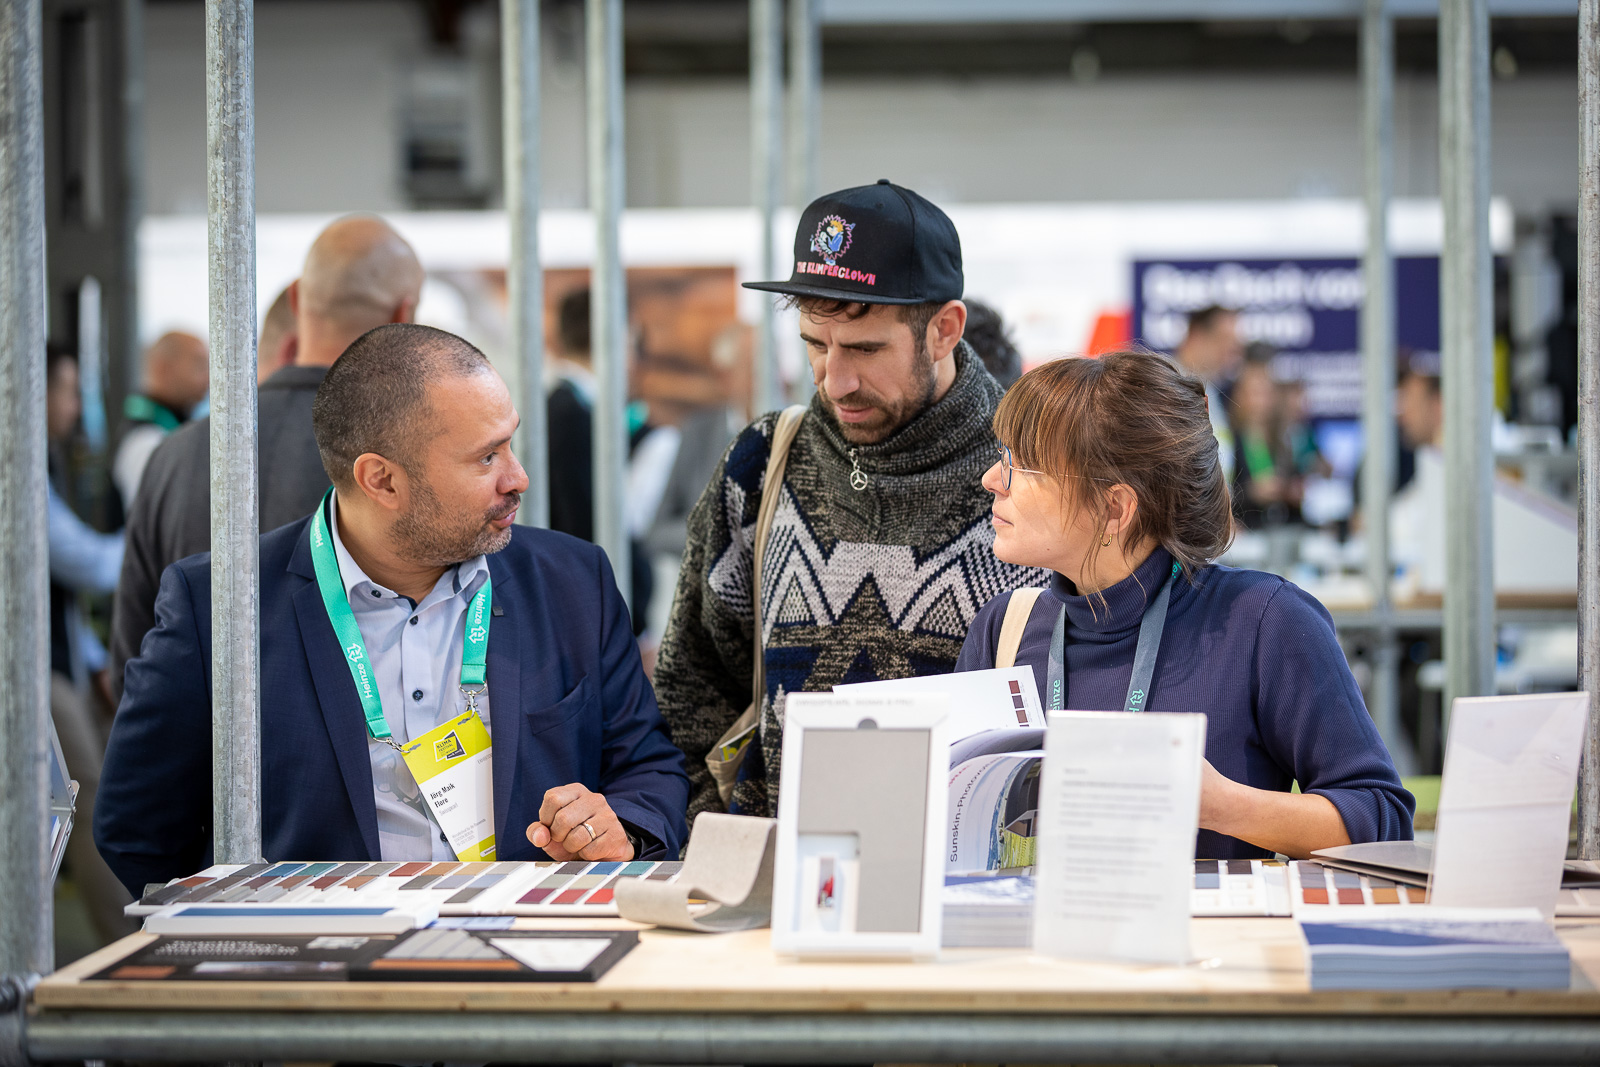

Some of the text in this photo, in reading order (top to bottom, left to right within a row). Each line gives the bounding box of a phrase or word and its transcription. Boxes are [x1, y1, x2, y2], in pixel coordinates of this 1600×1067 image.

[474, 592, 486, 625] Heinze
[357, 663, 373, 699] Heinze
[1050, 679, 1061, 711] einze
